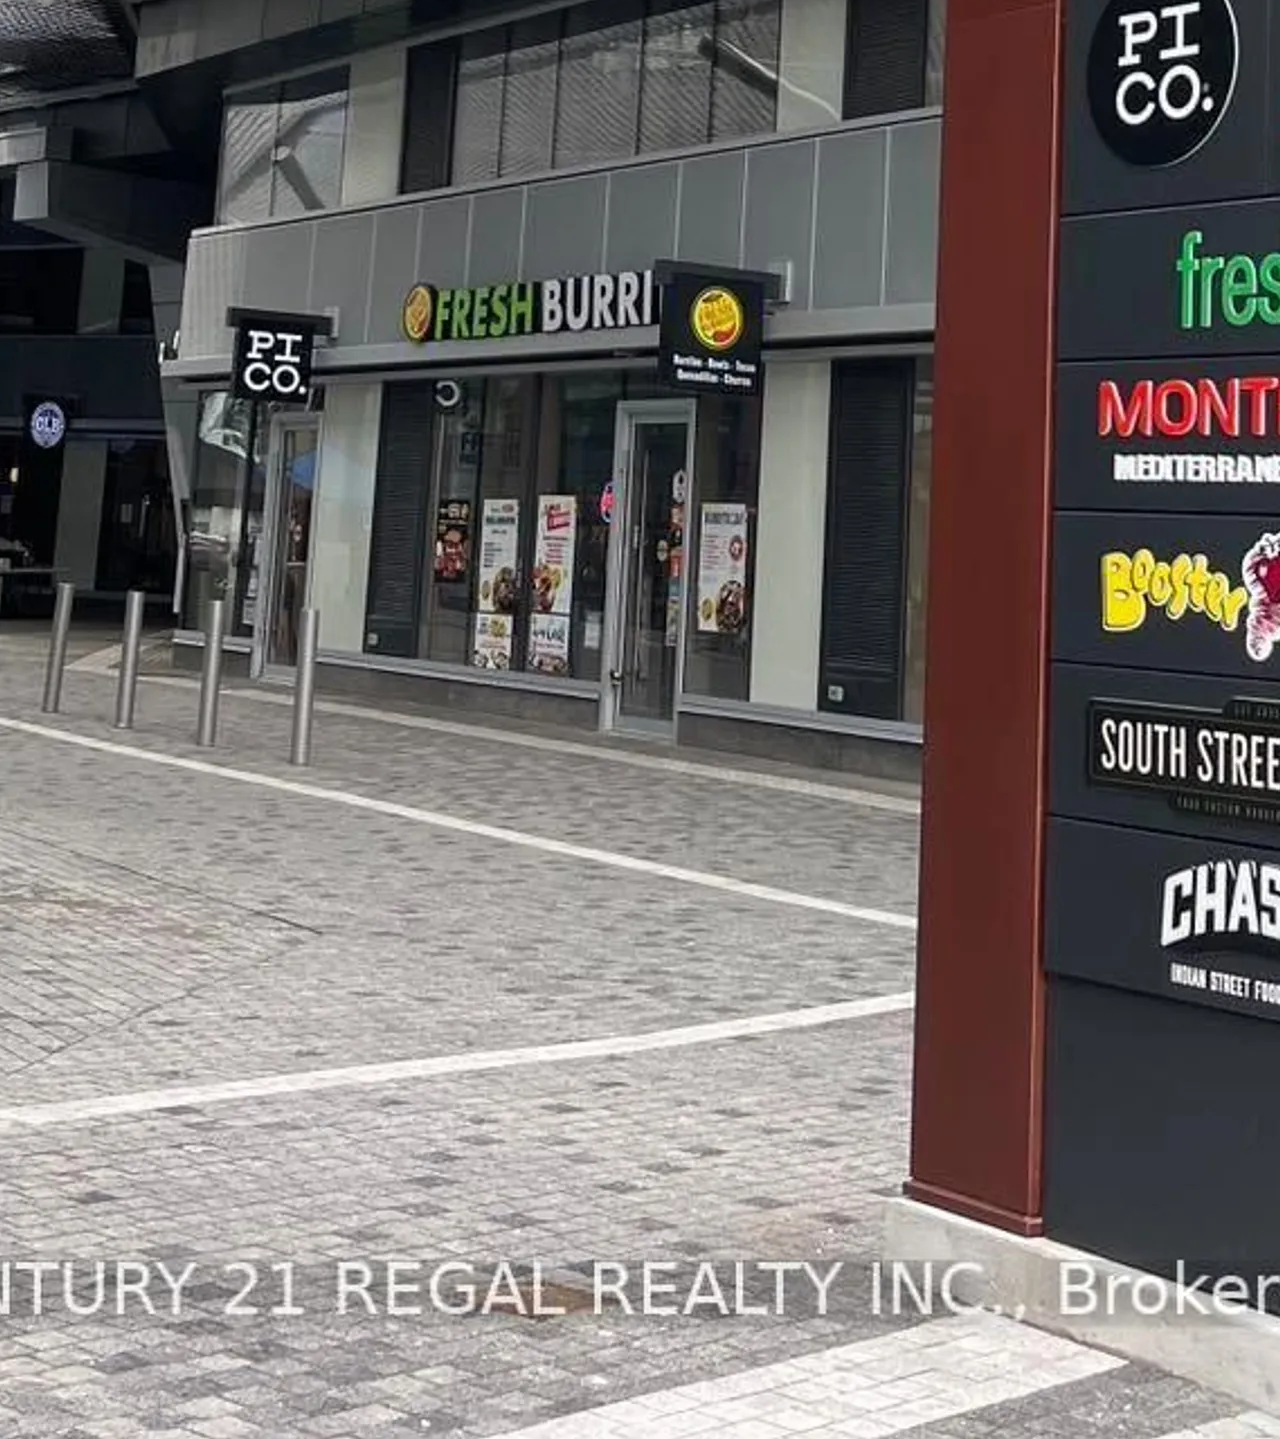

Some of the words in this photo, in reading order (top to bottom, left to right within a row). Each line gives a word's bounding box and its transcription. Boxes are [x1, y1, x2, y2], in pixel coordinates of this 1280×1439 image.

[1118, 1, 1201, 67] PI
[1115, 64, 1214, 125] CO.
[434, 281, 534, 341] FRESH
[542, 269, 653, 334] BURRI
[246, 330, 303, 363] PI
[243, 361, 307, 396] CO.
[1101, 548, 1249, 632] Booster
[1101, 718, 1187, 779] SOUTH
[1170, 962, 1208, 989] INDIAN
[1209, 971, 1251, 998] STREET
